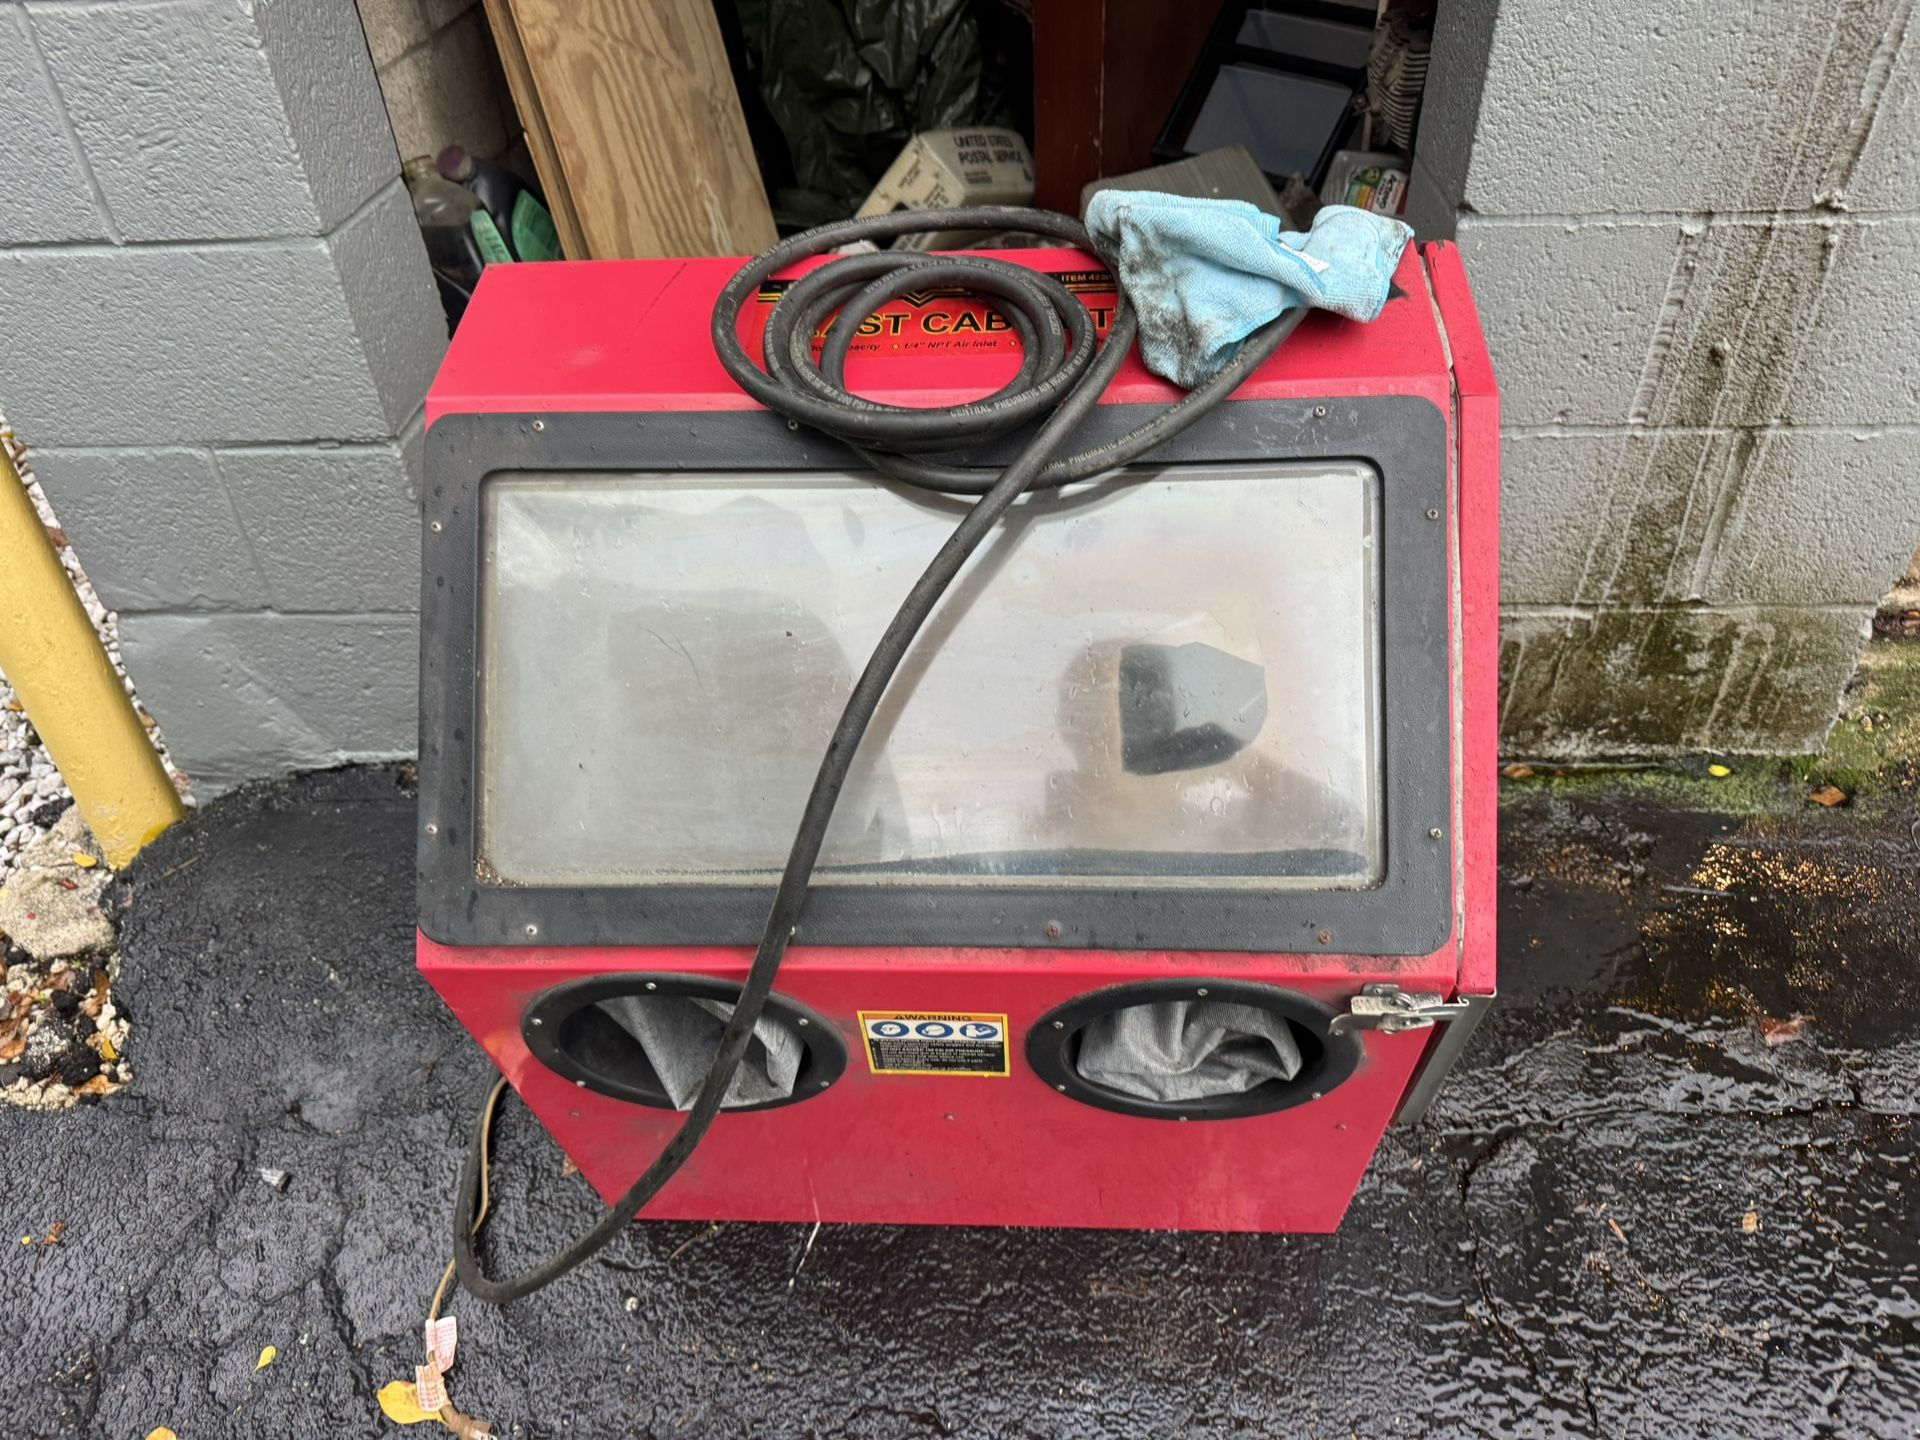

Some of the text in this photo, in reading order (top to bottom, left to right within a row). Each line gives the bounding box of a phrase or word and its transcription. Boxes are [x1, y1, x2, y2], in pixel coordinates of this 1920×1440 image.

[1061, 273, 1087, 282] ITEM
[927, 340, 952, 350] NPT
[972, 339, 999, 348] Inlet
[993, 388, 1040, 410] PNEUMATIC
[904, 1014, 973, 1022] WARNING
